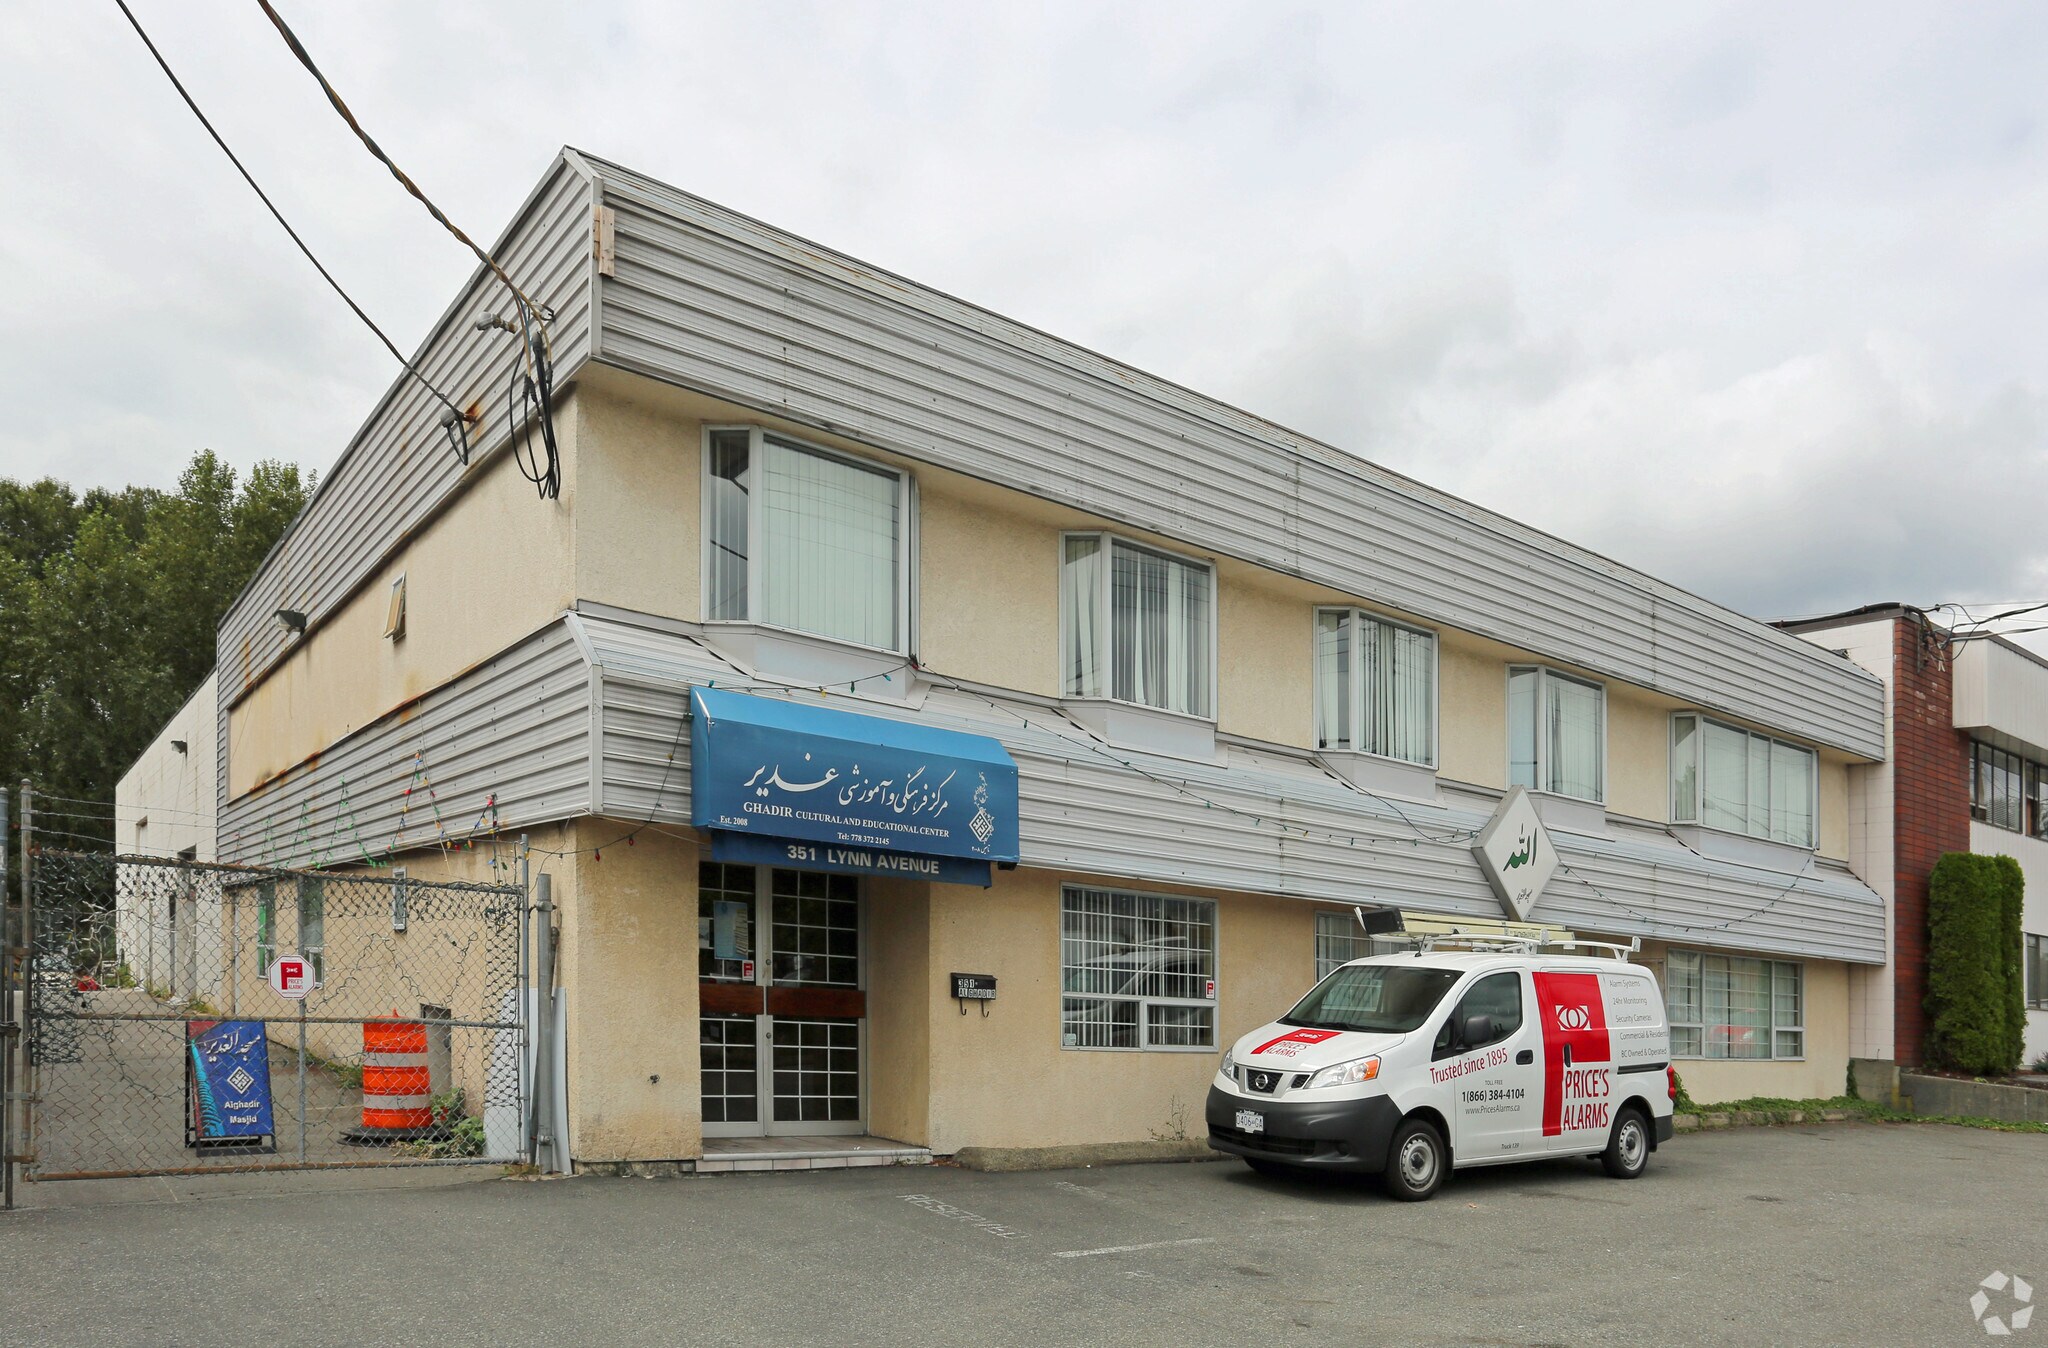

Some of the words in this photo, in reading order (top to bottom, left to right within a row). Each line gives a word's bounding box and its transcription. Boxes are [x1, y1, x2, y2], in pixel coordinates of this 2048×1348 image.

[720, 816, 732, 824] Est.
[733, 817, 748, 826] 2008
[743, 802, 792, 817] GHADIR
[796, 810, 842, 825] CULTURAL
[842, 817, 860, 827] AND
[863, 820, 918, 834] EDUCATIONAL
[920, 827, 949, 838] CENTER
[837, 832, 849, 840] Tel:
[788, 845, 816, 861] 351
[828, 849, 871, 867] LYNN
[877, 854, 939, 874] AVENUE
[1623, 980, 1640, 989] Systems
[1623, 997, 1647, 1005] Monitoring
[1616, 1014, 1633, 1023] Security
[1620, 1031, 1645, 1040] Commercial
[1264, 1047, 1300, 1057] ALARMS
[1648, 1048, 1667, 1056] Operated
[1430, 1060, 1462, 1084] Trusted
[1464, 1058, 1485, 1074] since
[1486, 1048, 1508, 1068] 1895
[1566, 1069, 1609, 1099] PRICE'S
[1462, 1090, 1487, 1103] 1(866)
[1489, 1088, 1525, 1101] 384-4104
[1465, 1105, 1520, 1114] www.PricesAlarms.ca
[230, 1115, 257, 1124] Masjid
[1564, 1102, 1609, 1130] ALARMS
